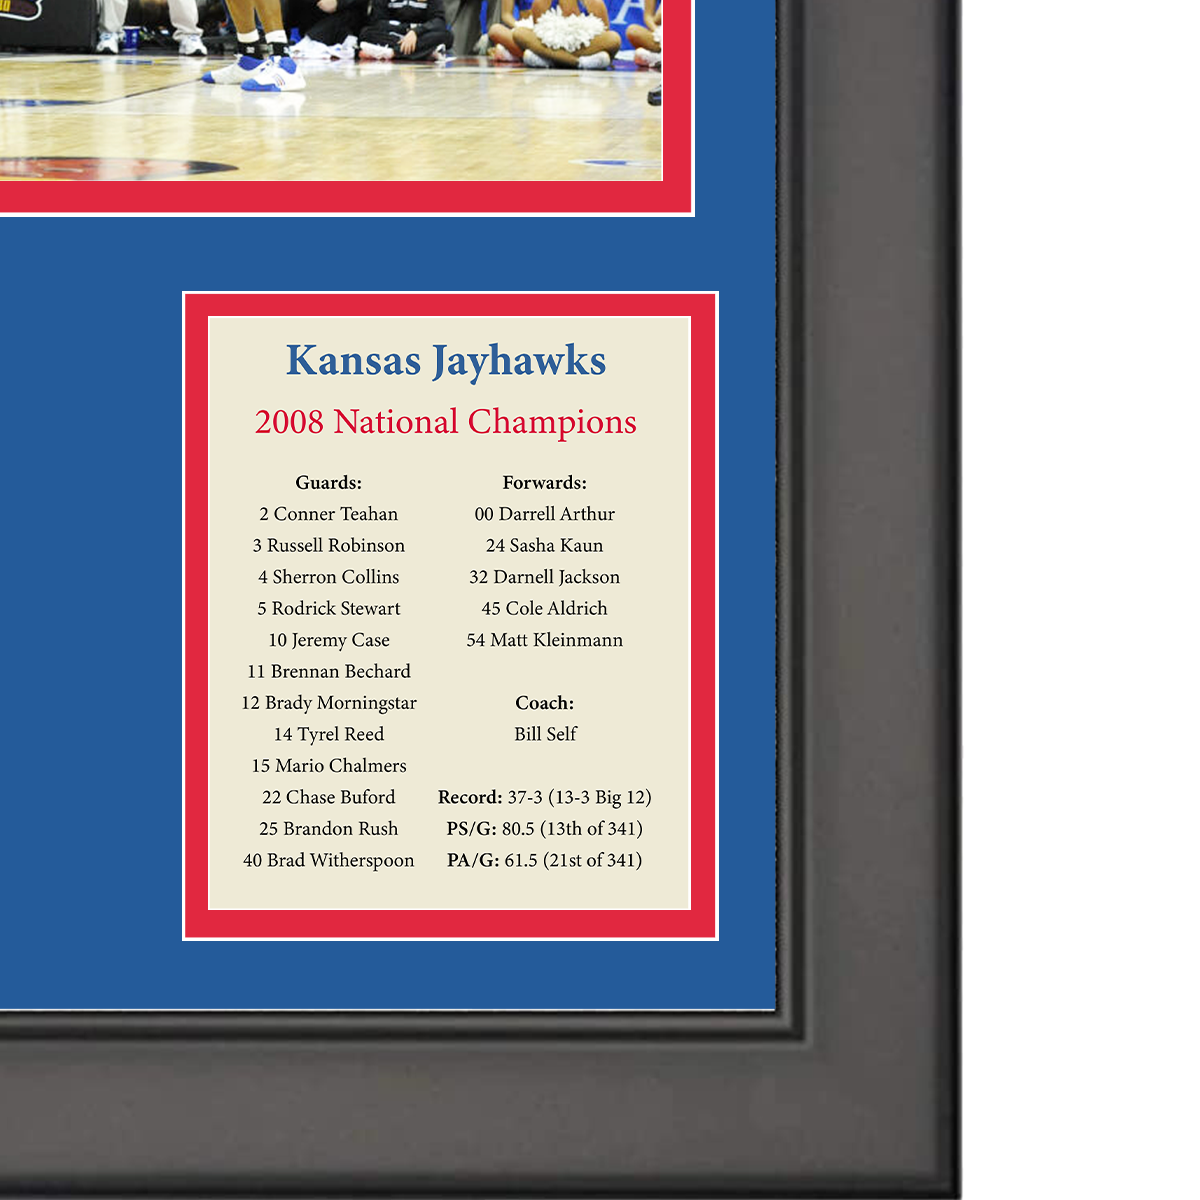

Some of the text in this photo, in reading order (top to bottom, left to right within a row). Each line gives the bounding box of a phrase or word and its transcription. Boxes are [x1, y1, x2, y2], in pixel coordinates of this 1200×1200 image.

[285, 342, 607, 386] Kansas Jayhawks
[254, 406, 637, 443] 2008 National Champions
[295, 474, 362, 491] Guards:
[502, 474, 587, 491] Forwards:
[259, 505, 399, 522] 2 Conner Teahan
[474, 505, 616, 522] 00 Darrell Arthur
[252, 536, 406, 553] 3 Russell Robinson
[485, 536, 604, 553] 24 Sasha Kaun
[257, 568, 400, 585] 4 Sherron Collins
[469, 568, 621, 588] 32 Darnell Jackson
[257, 599, 402, 616] 5 Rodrick Stewart
[481, 599, 609, 616] 45 Cole Aldrich
[269, 631, 390, 653] 10 Jeremy Case
[466, 631, 624, 648] 54 Matt Kleinmann
[248, 662, 412, 679] 11 Brennan Bechard
[241, 693, 418, 715] 12 Brady Morningstar
[515, 694, 574, 711] Coach:
[274, 725, 385, 747] 14 Tyrel Reed
[514, 725, 579, 742] Bill Self
[252, 756, 407, 774] 15 Mario Chalmers
[262, 788, 397, 805] 22 Chase Buford
[437, 787, 652, 810] Record: 37-3 (13-3 Big 12)
[259, 819, 399, 837] 25 Brandon Rush
[446, 819, 643, 840] PS/G: 80.5 (13th of 341)
[242, 851, 415, 873] 40 Brad Witherspoon
[446, 850, 643, 872] PA/G: 61.5 (21st of 341)
